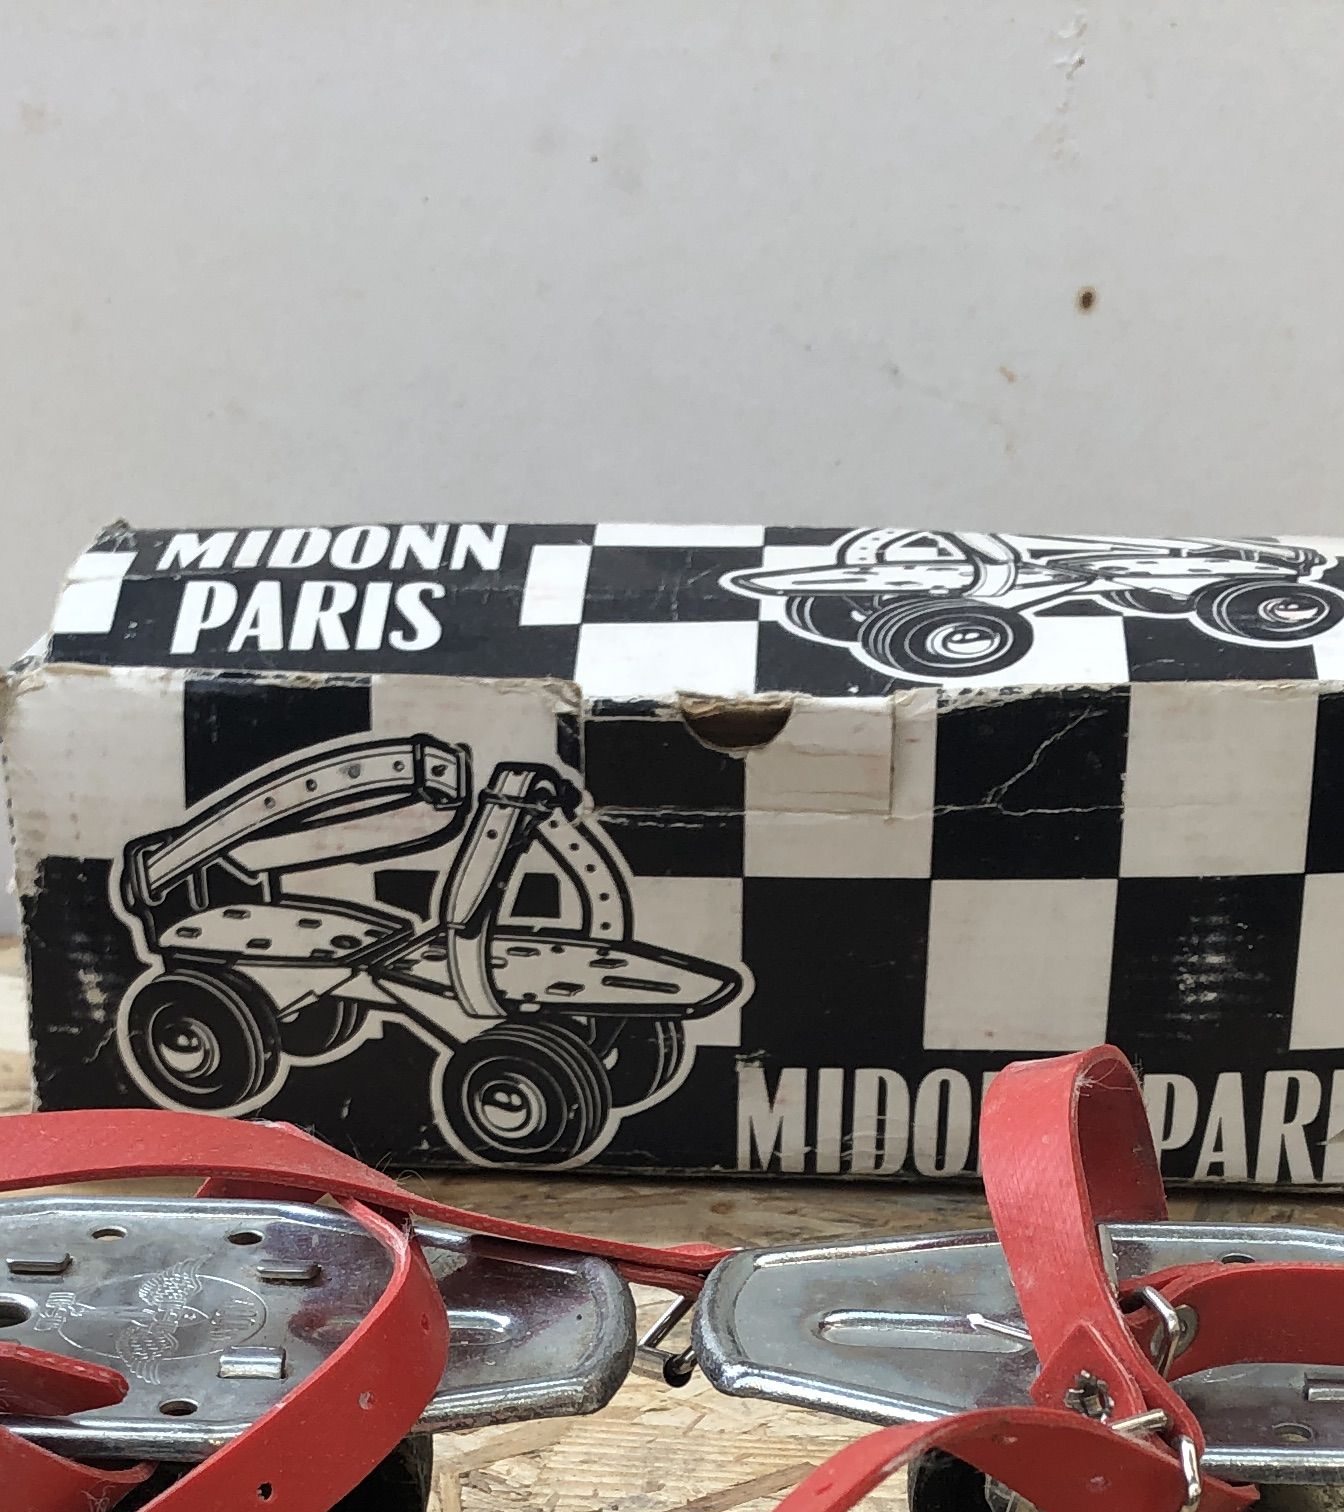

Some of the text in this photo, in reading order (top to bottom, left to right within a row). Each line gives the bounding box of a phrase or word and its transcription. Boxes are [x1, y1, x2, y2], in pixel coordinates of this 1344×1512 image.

[156, 523, 508, 571] MIDONN
[169, 580, 446, 655] PARIS
[736, 1064, 1002, 1177] MIDO
